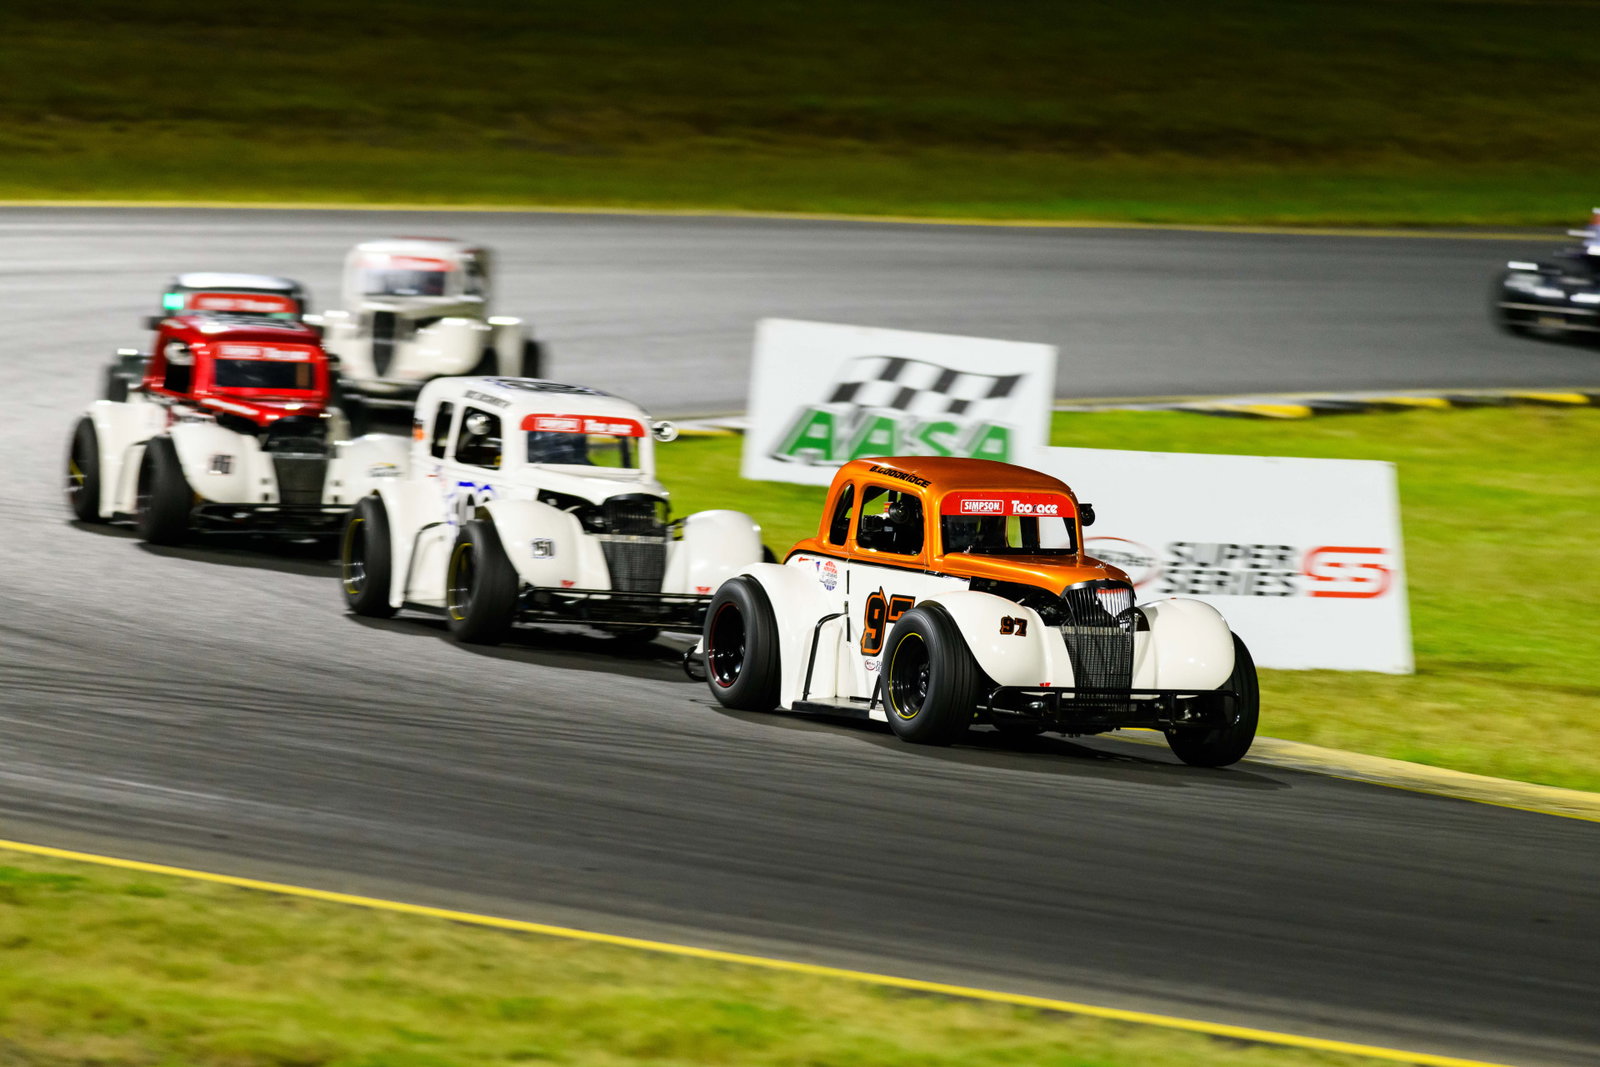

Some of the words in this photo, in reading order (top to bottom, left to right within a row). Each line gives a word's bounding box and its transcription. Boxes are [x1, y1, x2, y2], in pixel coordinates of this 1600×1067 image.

[775, 407, 1014, 461] AASA
[964, 501, 1000, 511] SIMPSON
[1166, 542, 1296, 569] SUPER
[1158, 568, 1298, 597] SERIES
[999, 614, 1028, 637] 97
